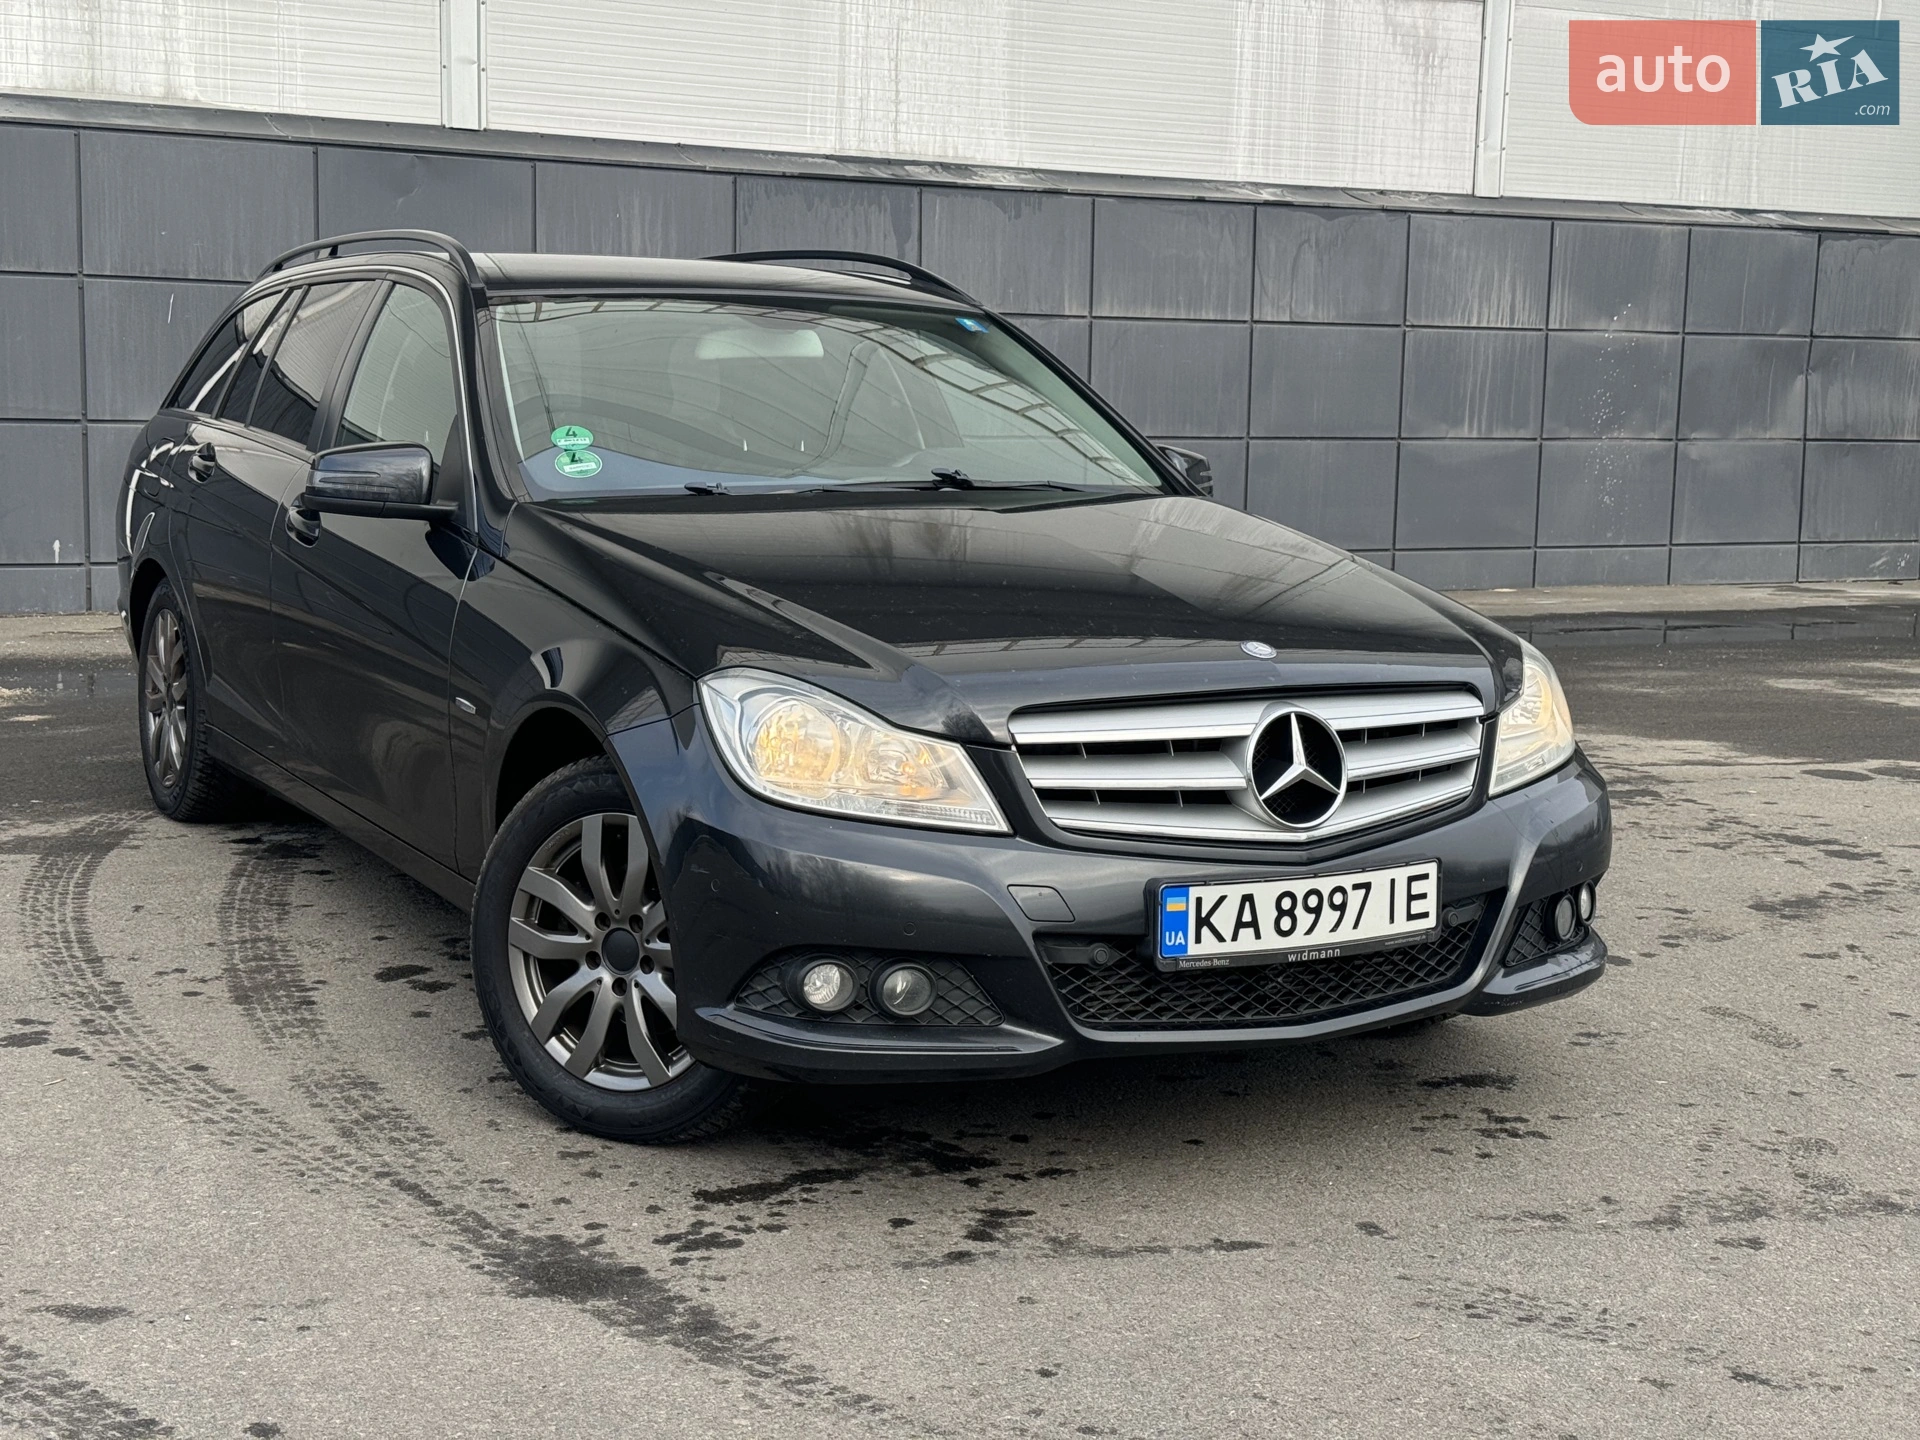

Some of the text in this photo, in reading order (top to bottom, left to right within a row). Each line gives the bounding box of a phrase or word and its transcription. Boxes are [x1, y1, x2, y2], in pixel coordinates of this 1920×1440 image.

[1194, 872, 1430, 945] KA 8997 IE
[1165, 931, 1186, 947] UA
[1288, 949, 1341, 962] widmann
